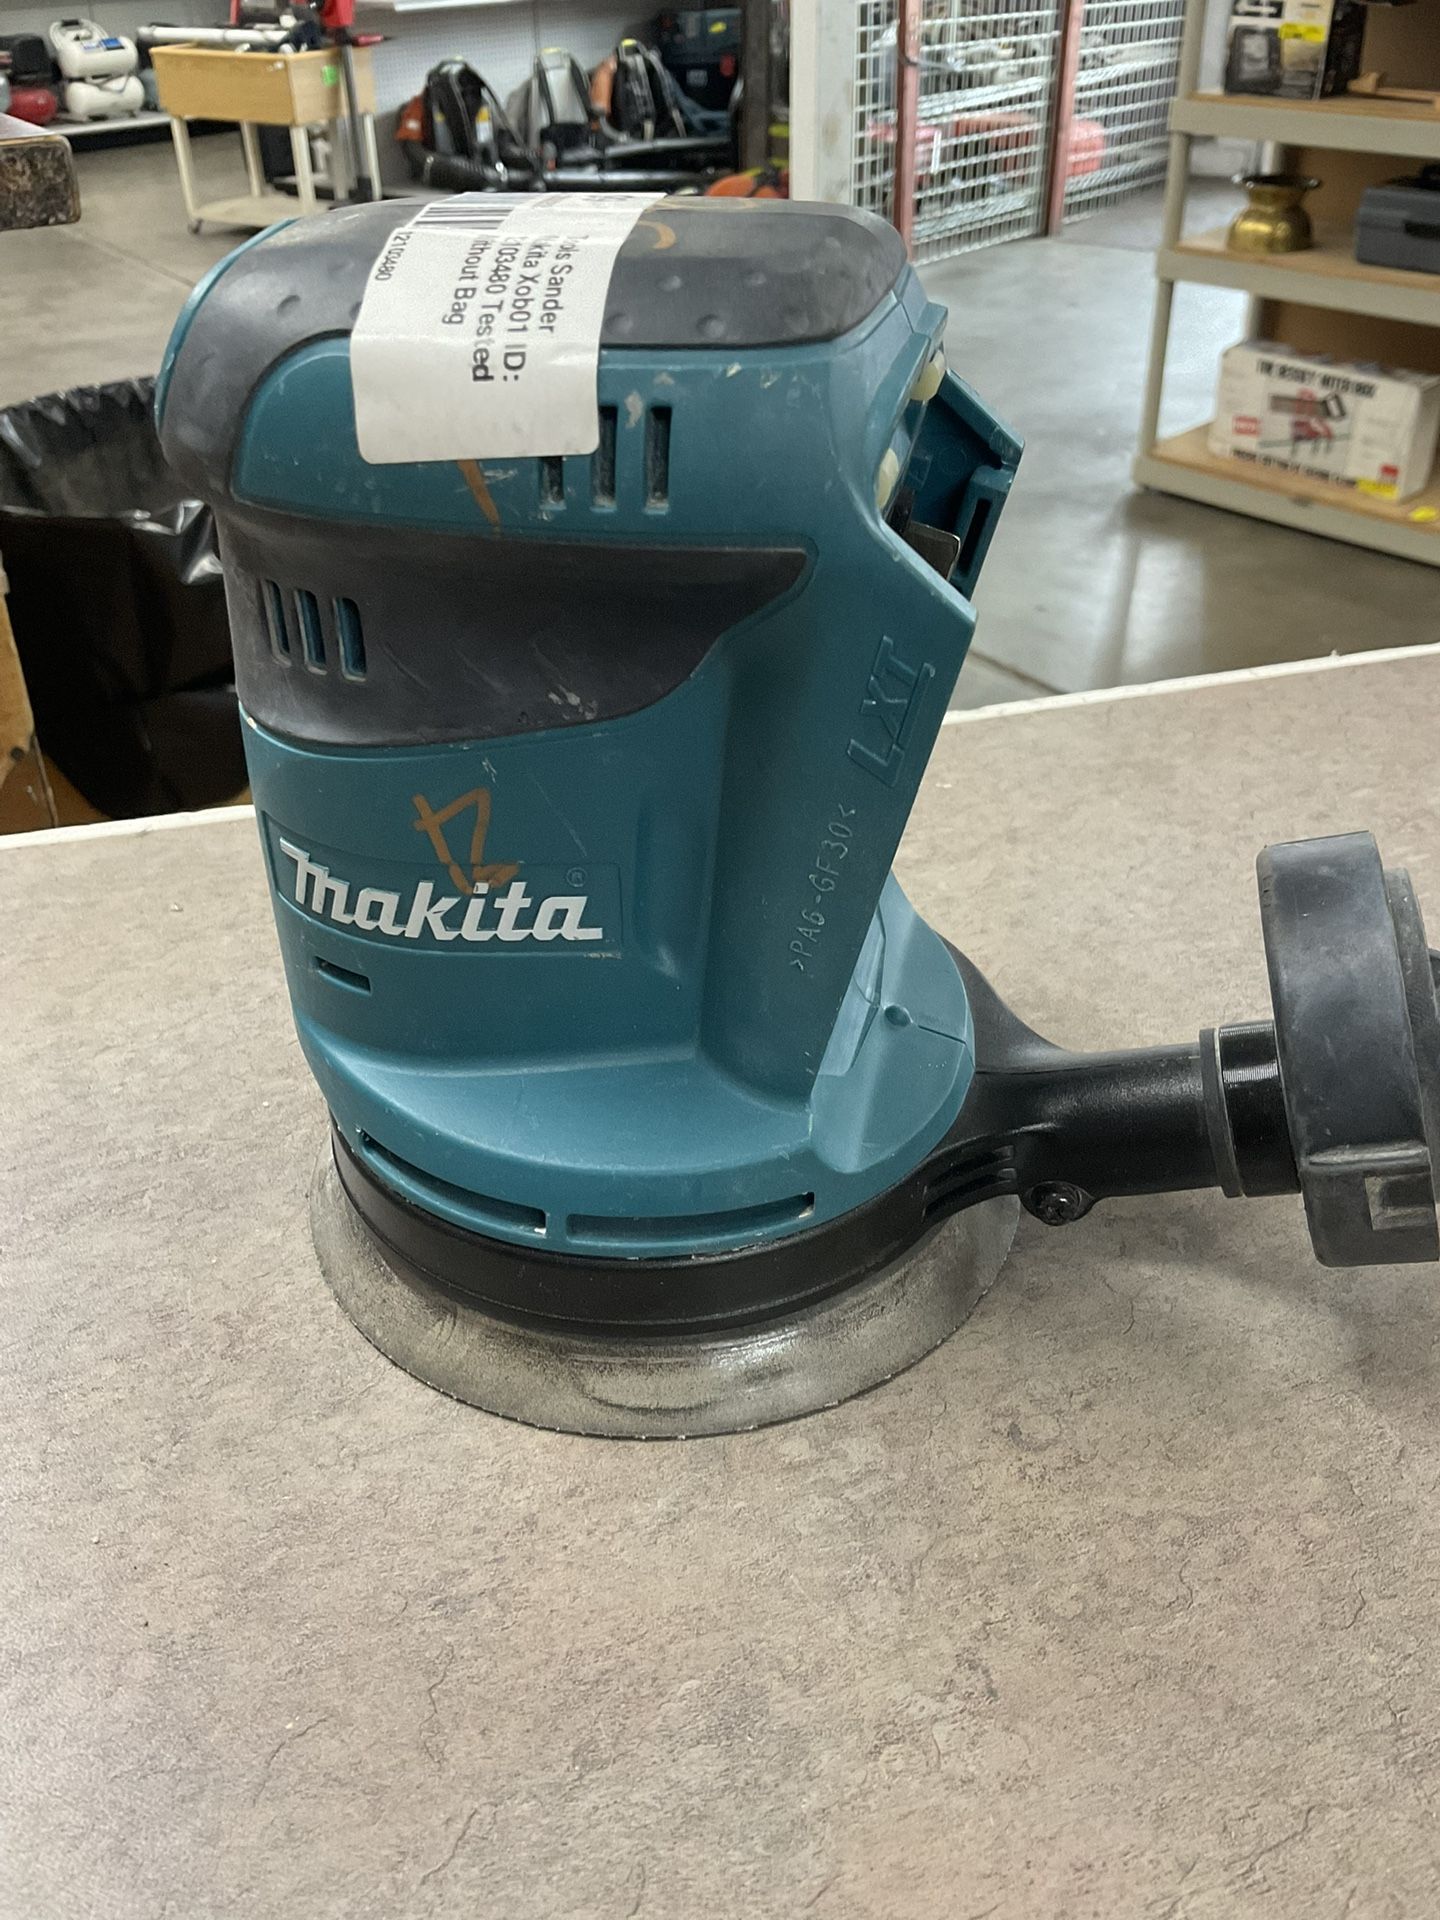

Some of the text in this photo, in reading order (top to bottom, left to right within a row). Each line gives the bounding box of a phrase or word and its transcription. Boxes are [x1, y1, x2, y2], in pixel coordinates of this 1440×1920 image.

[441, 287, 477, 325] Bag
[507, 273, 541, 332] Xob01
[539, 264, 573, 333] Sander
[472, 299, 504, 382] Tested
[503, 343, 526, 382] ID:
[847, 635, 936, 788] LXT
